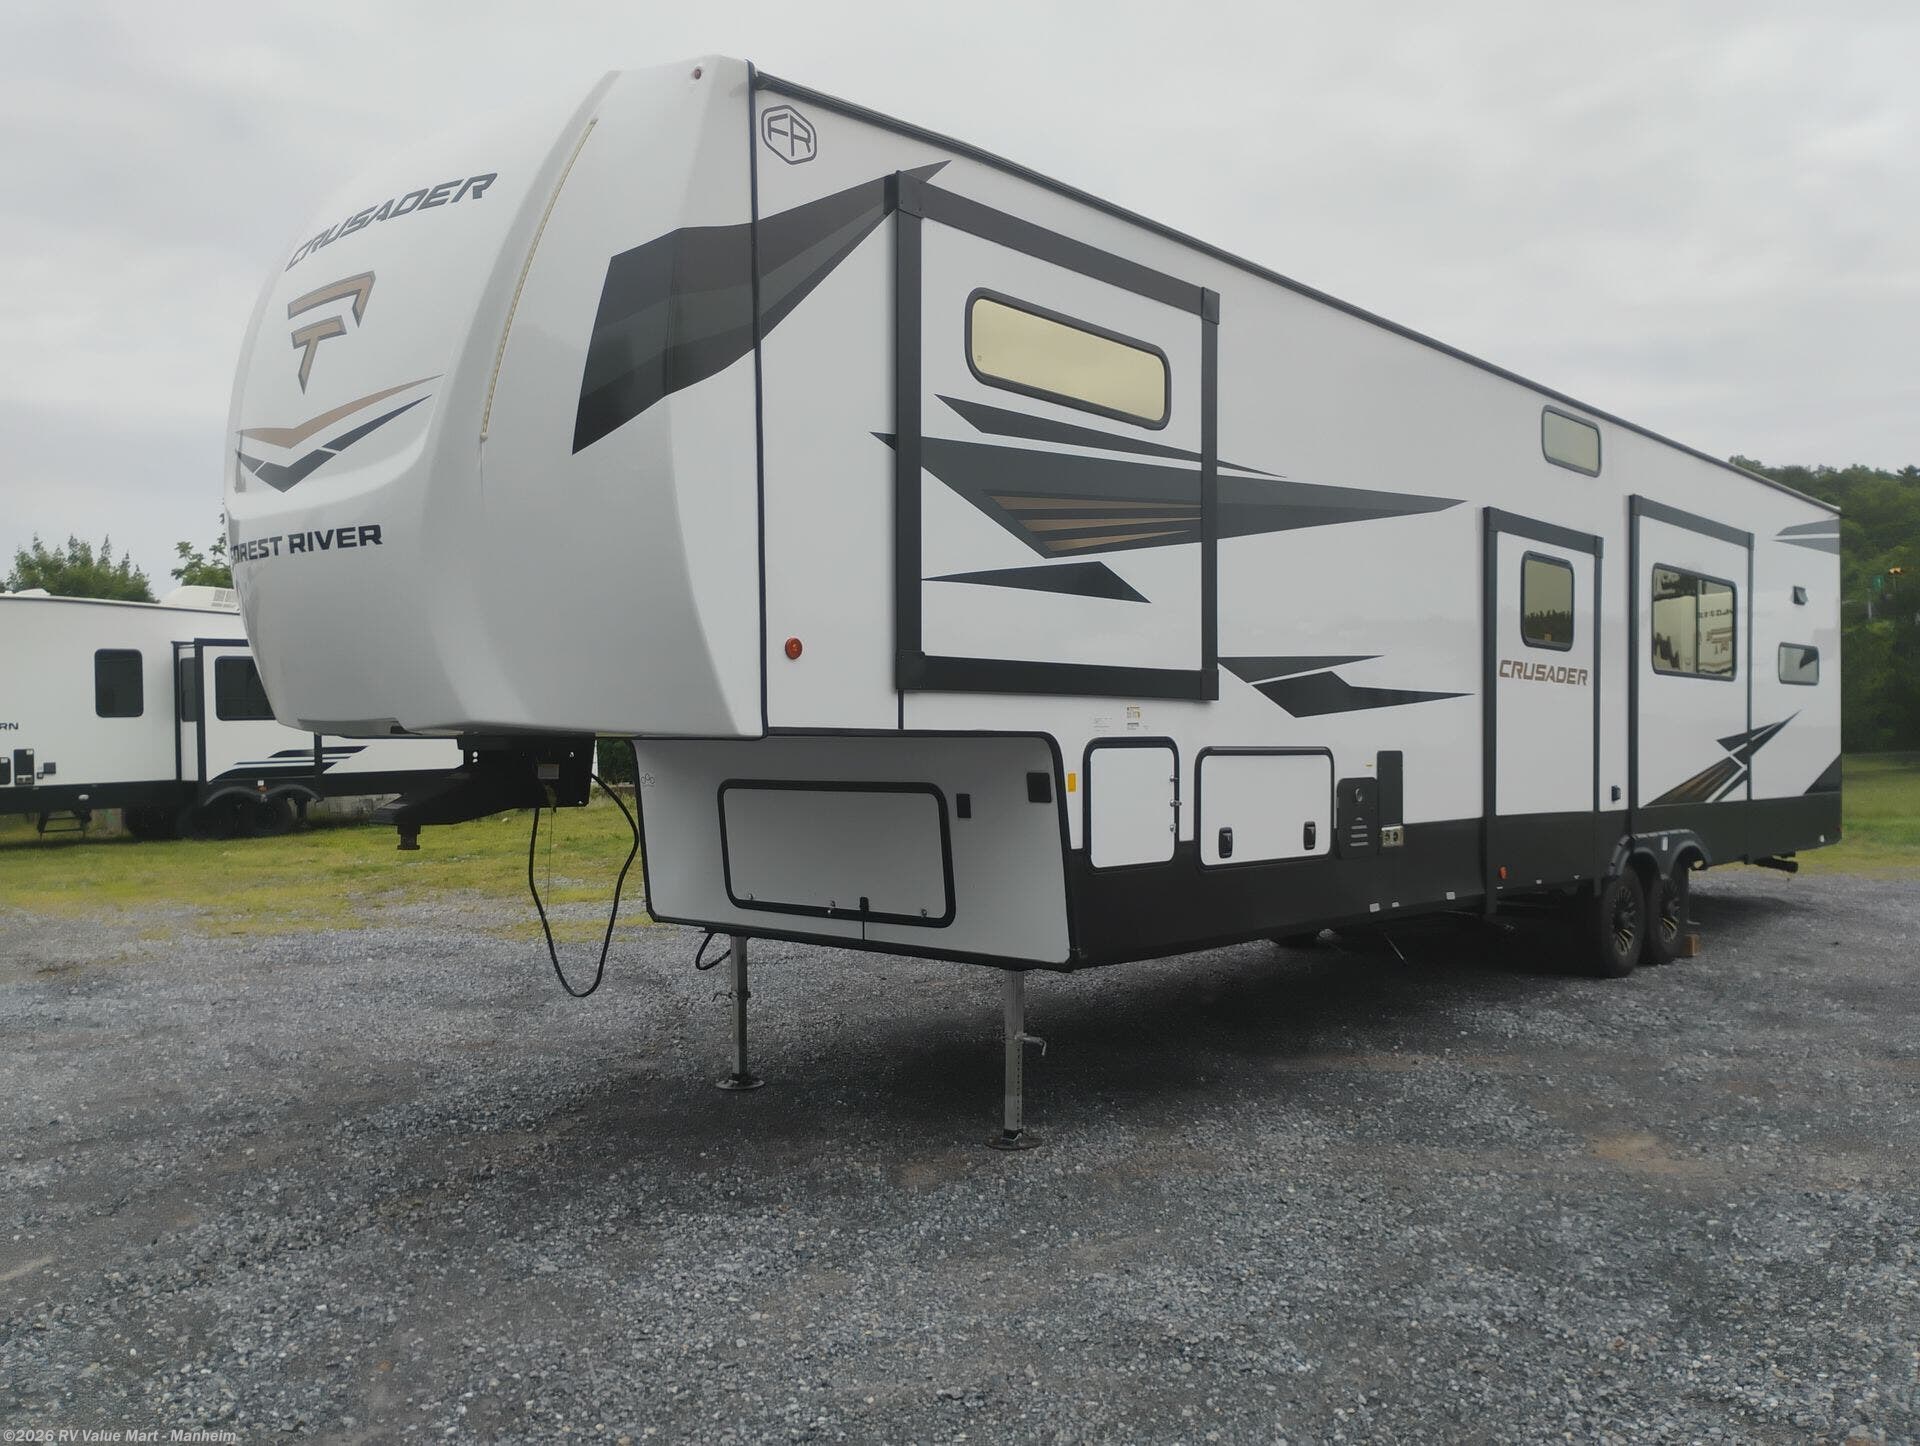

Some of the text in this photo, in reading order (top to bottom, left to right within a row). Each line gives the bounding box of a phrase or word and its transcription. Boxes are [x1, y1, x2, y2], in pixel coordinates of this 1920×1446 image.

[285, 172, 498, 272] CRUSADER
[288, 524, 383, 554] RIVER
[1499, 659, 1588, 686] CRUSADER
